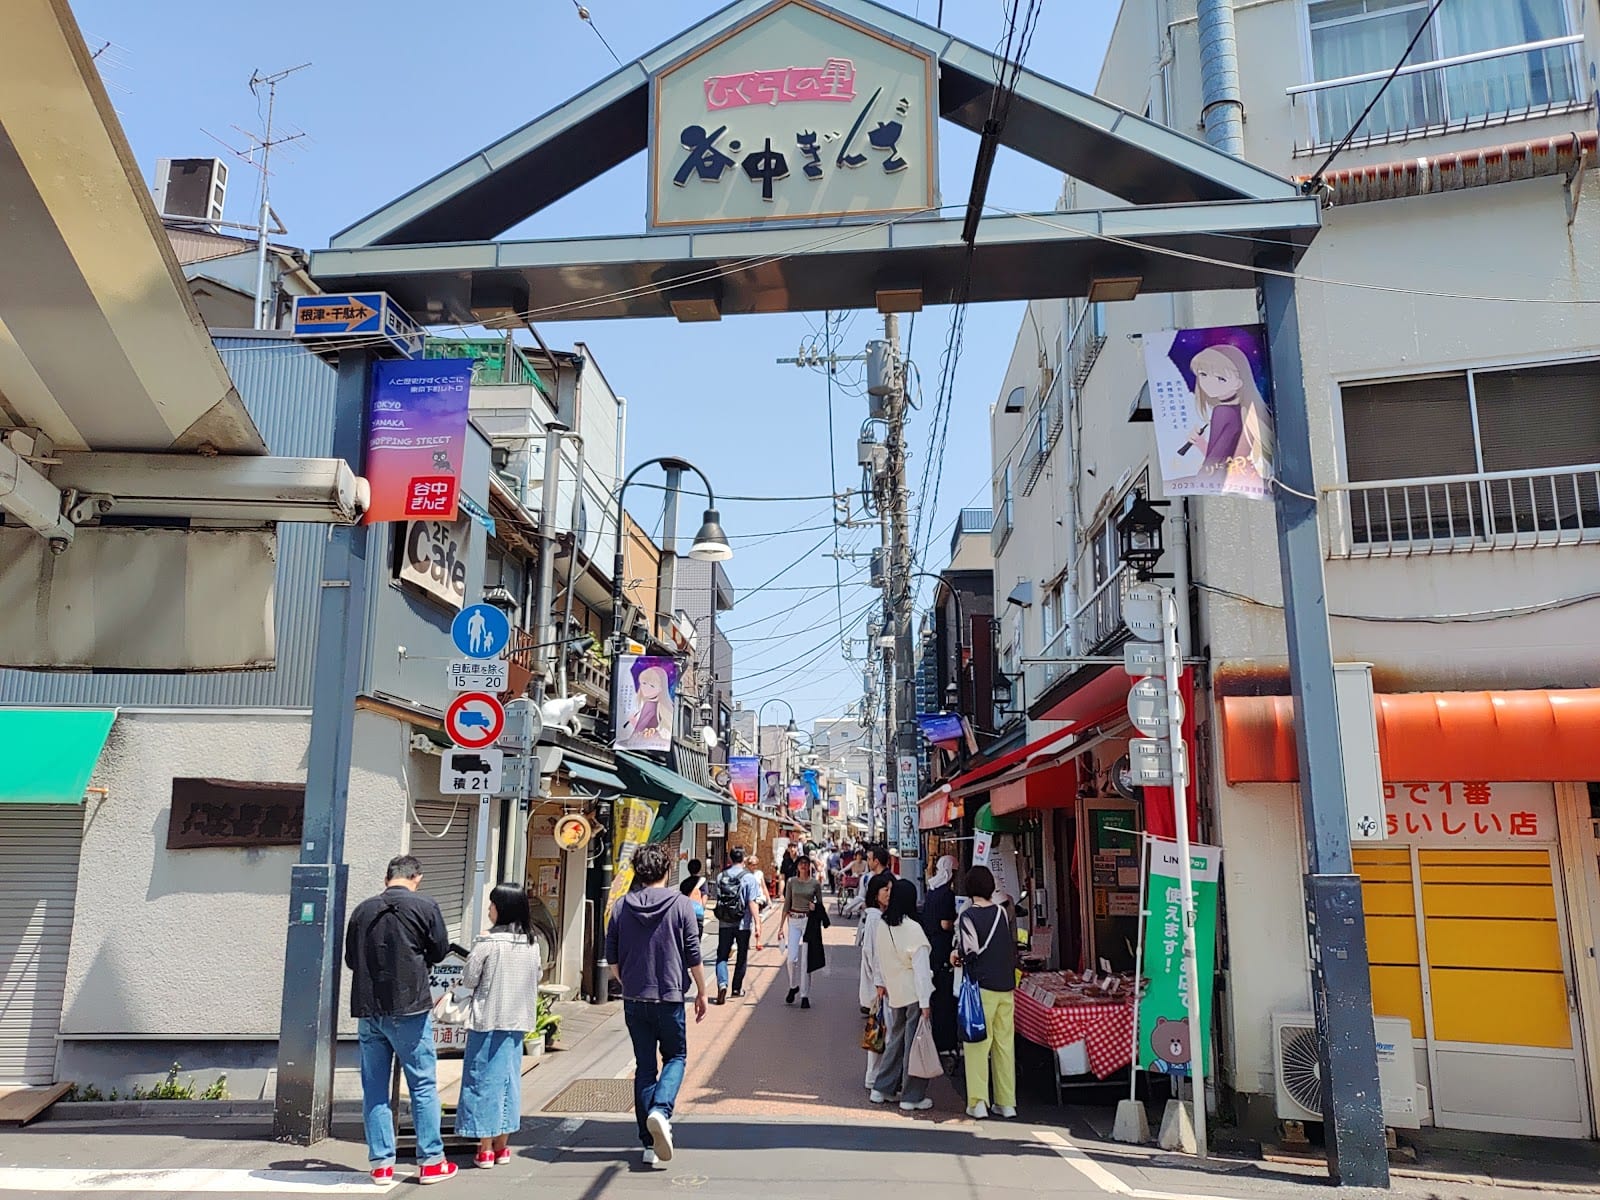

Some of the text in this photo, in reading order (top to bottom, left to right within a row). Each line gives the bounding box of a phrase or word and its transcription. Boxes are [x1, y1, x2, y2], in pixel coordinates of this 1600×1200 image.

[708, 57, 857, 107] ひぐらしの里
[673, 86, 911, 202] 谷中ぎんざ
[301, 307, 368, 322] 根津・千駄木
[416, 436, 452, 445] STREET
[414, 482, 448, 496] 谷中
[411, 497, 448, 510] ぎんざ
[432, 521, 450, 545] 2F
[407, 520, 466, 597] Cafe
[452, 663, 505, 674] 自転車を除く
[455, 676, 466, 687] 15
[485, 676, 501, 688] 20
